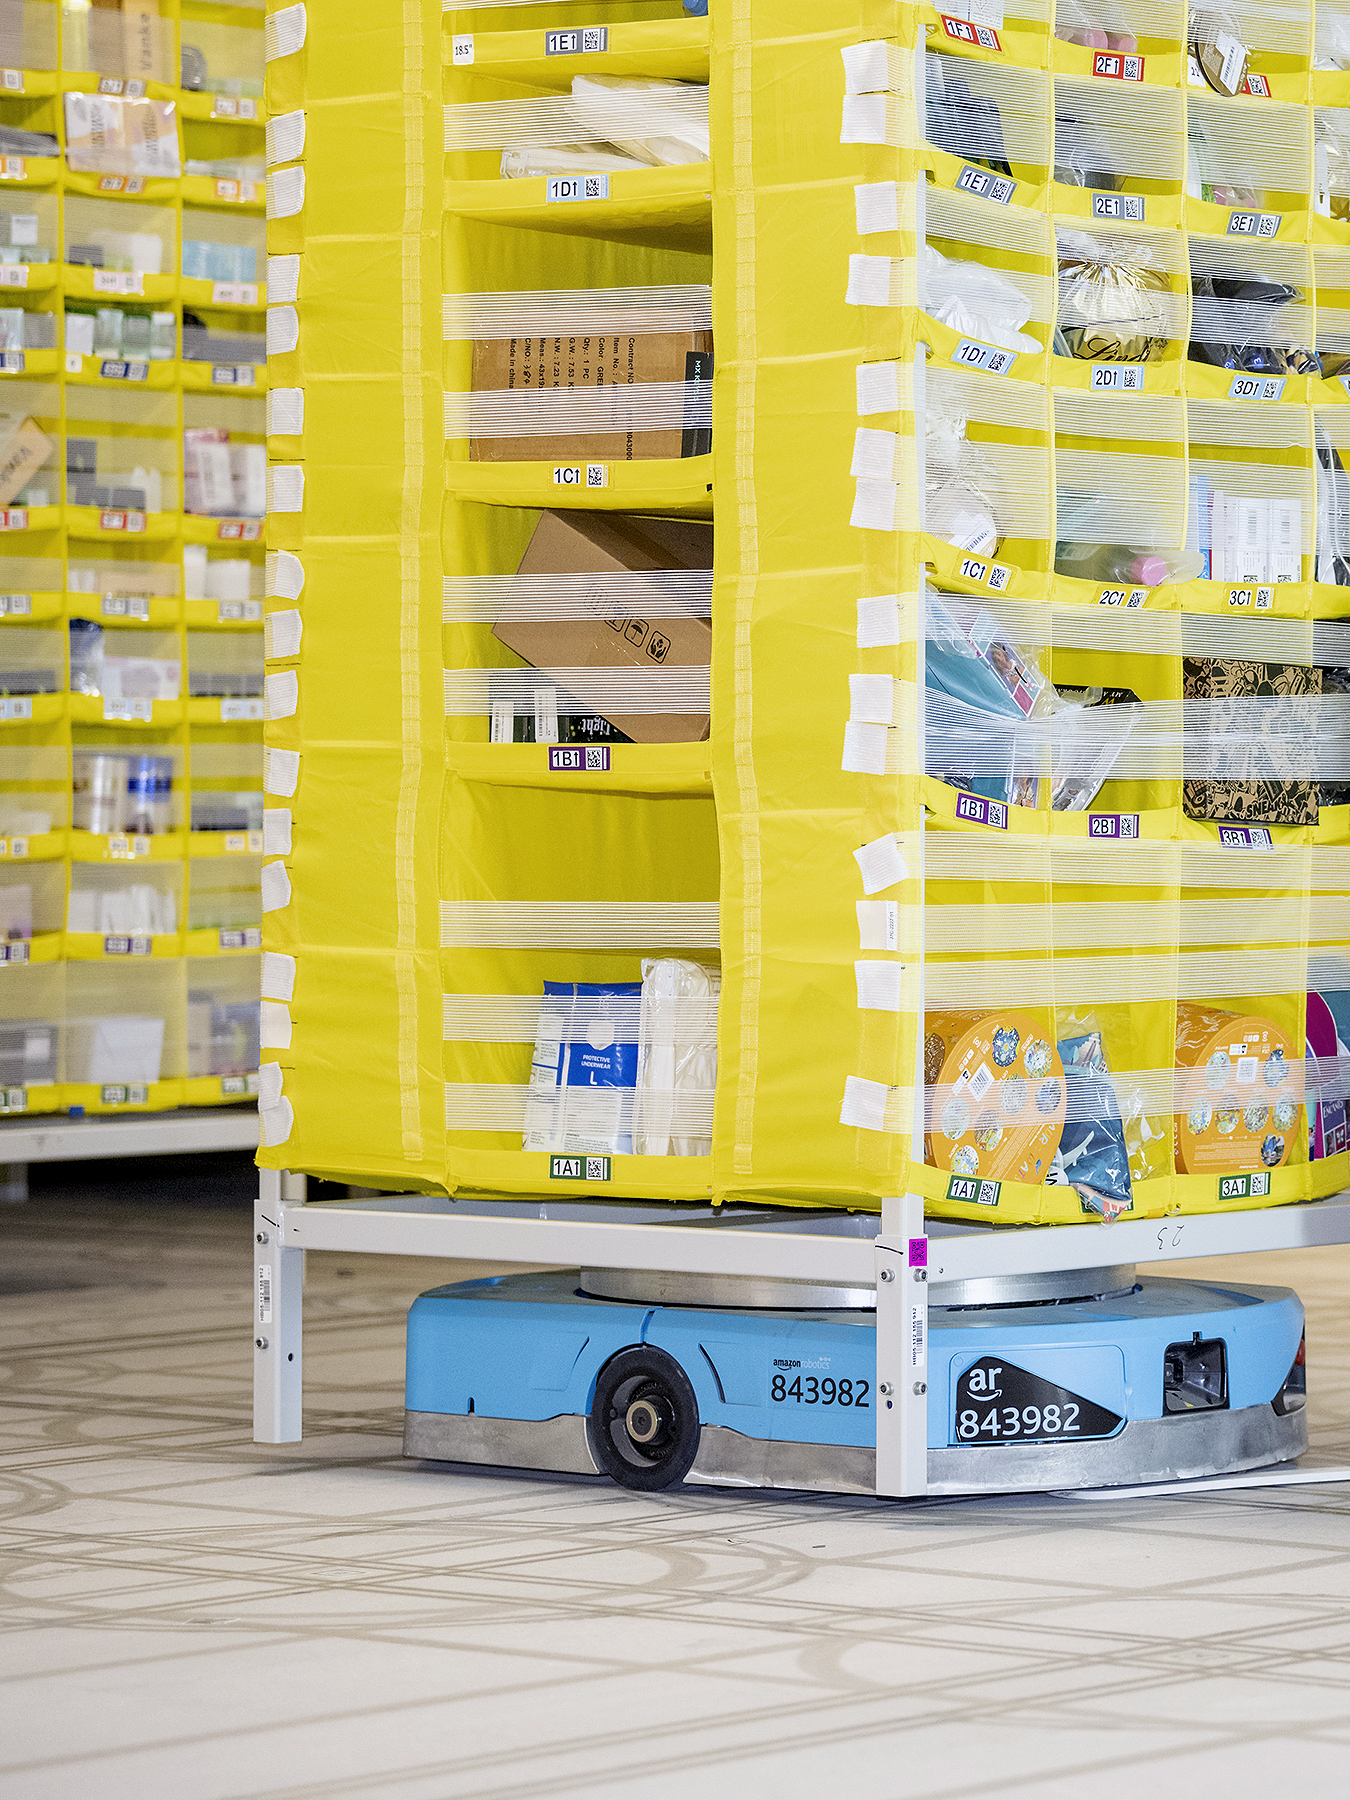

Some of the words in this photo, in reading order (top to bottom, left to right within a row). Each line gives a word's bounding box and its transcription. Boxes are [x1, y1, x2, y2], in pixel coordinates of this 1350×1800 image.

[947, 20, 963, 38] 1F
[550, 34, 568, 51] 1E
[1096, 56, 1112, 73] 2F
[552, 181, 571, 197] 1D
[964, 172, 982, 191] 1E
[1096, 197, 1113, 214] 2E
[1231, 216, 1247, 231] 3E
[628, 337, 636, 370] Contract
[961, 345, 978, 362] 1D
[567, 362, 575, 378] 7.53
[582, 368, 589, 379] PC
[694, 360, 701, 374] MX
[1095, 370, 1112, 386] 2D
[1234, 380, 1253, 396] 3D
[553, 467, 573, 484] 1C
[962, 560, 981, 579] 1C
[1099, 590, 1116, 606] 2C
[1229, 590, 1247, 606] 3C
[553, 751, 572, 767] 1B
[961, 799, 978, 818] 1B
[1093, 819, 1109, 834] 2B
[1223, 830, 1240, 845] 3B
[581, 1061, 611, 1070] UNDERWEAR
[582, 1054, 611, 1064] PROTECTIVE
[590, 1071, 598, 1085] L
[553, 1159, 573, 1176] 1A
[951, 1179, 970, 1198] 1A
[1222, 1179, 1239, 1196] 3A
[968, 1366, 1003, 1393] ar
[771, 1374, 870, 1408] 843982
[959, 1402, 1081, 1438] 843982
